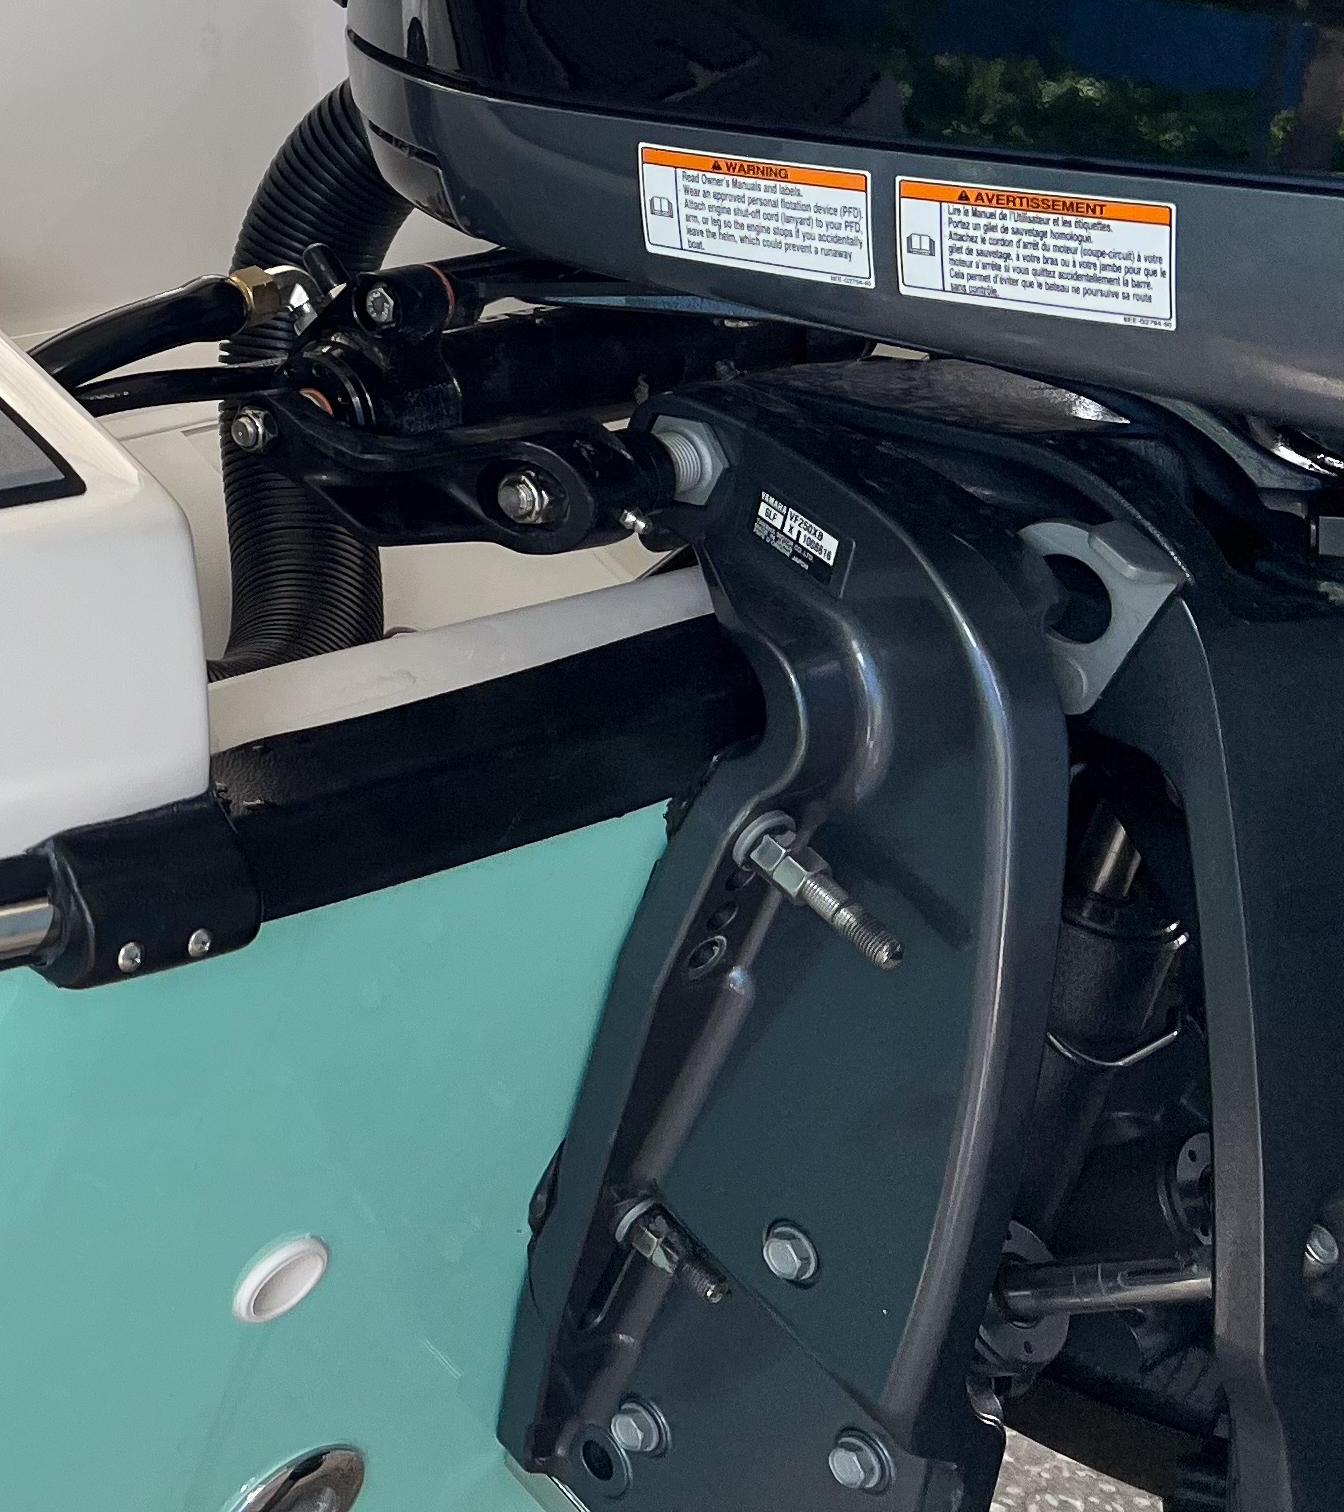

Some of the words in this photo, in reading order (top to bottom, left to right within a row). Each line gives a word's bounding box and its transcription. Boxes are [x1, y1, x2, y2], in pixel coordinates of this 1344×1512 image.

[682, 171, 699, 183] Read
[702, 174, 730, 188] Owner's
[732, 178, 761, 192] Manuals
[763, 184, 777, 194] and
[779, 184, 803, 197] labels.
[725, 161, 789, 179] WARNING
[683, 184, 700, 197] Wear
[702, 189, 711, 198] an
[712, 191, 745, 204] approved
[747, 196, 778, 208] personal
[813, 203, 838, 216] device
[974, 192, 1107, 216] AVERTISSEMENT
[684, 198, 706, 210] Attach
[708, 204, 731, 216] engine
[733, 208, 760, 219] shut-off
[763, 212, 779, 222] cord
[781, 212, 813, 229] (lanyard)
[816, 218, 823, 228] to
[825, 221, 842, 232] your
[686, 225, 704, 237] leave
[705, 228, 716, 239] the
[739, 235, 760, 245] which
[762, 238, 782, 249] could
[784, 242, 812, 255] prevent
[814, 246, 819, 255] a
[821, 248, 852, 262] runaway
[702, 217, 709, 225] or
[711, 216, 721, 229] leg
[723, 220, 732, 229] so
[734, 219, 744, 230] the
[747, 223, 770, 236] engine
[772, 226, 793, 239] stops
[795, 228, 800, 238] if
[802, 232, 816, 242] you
[818, 233, 863, 249] accidentally
[762, 491, 788, 515] YAMAHA
